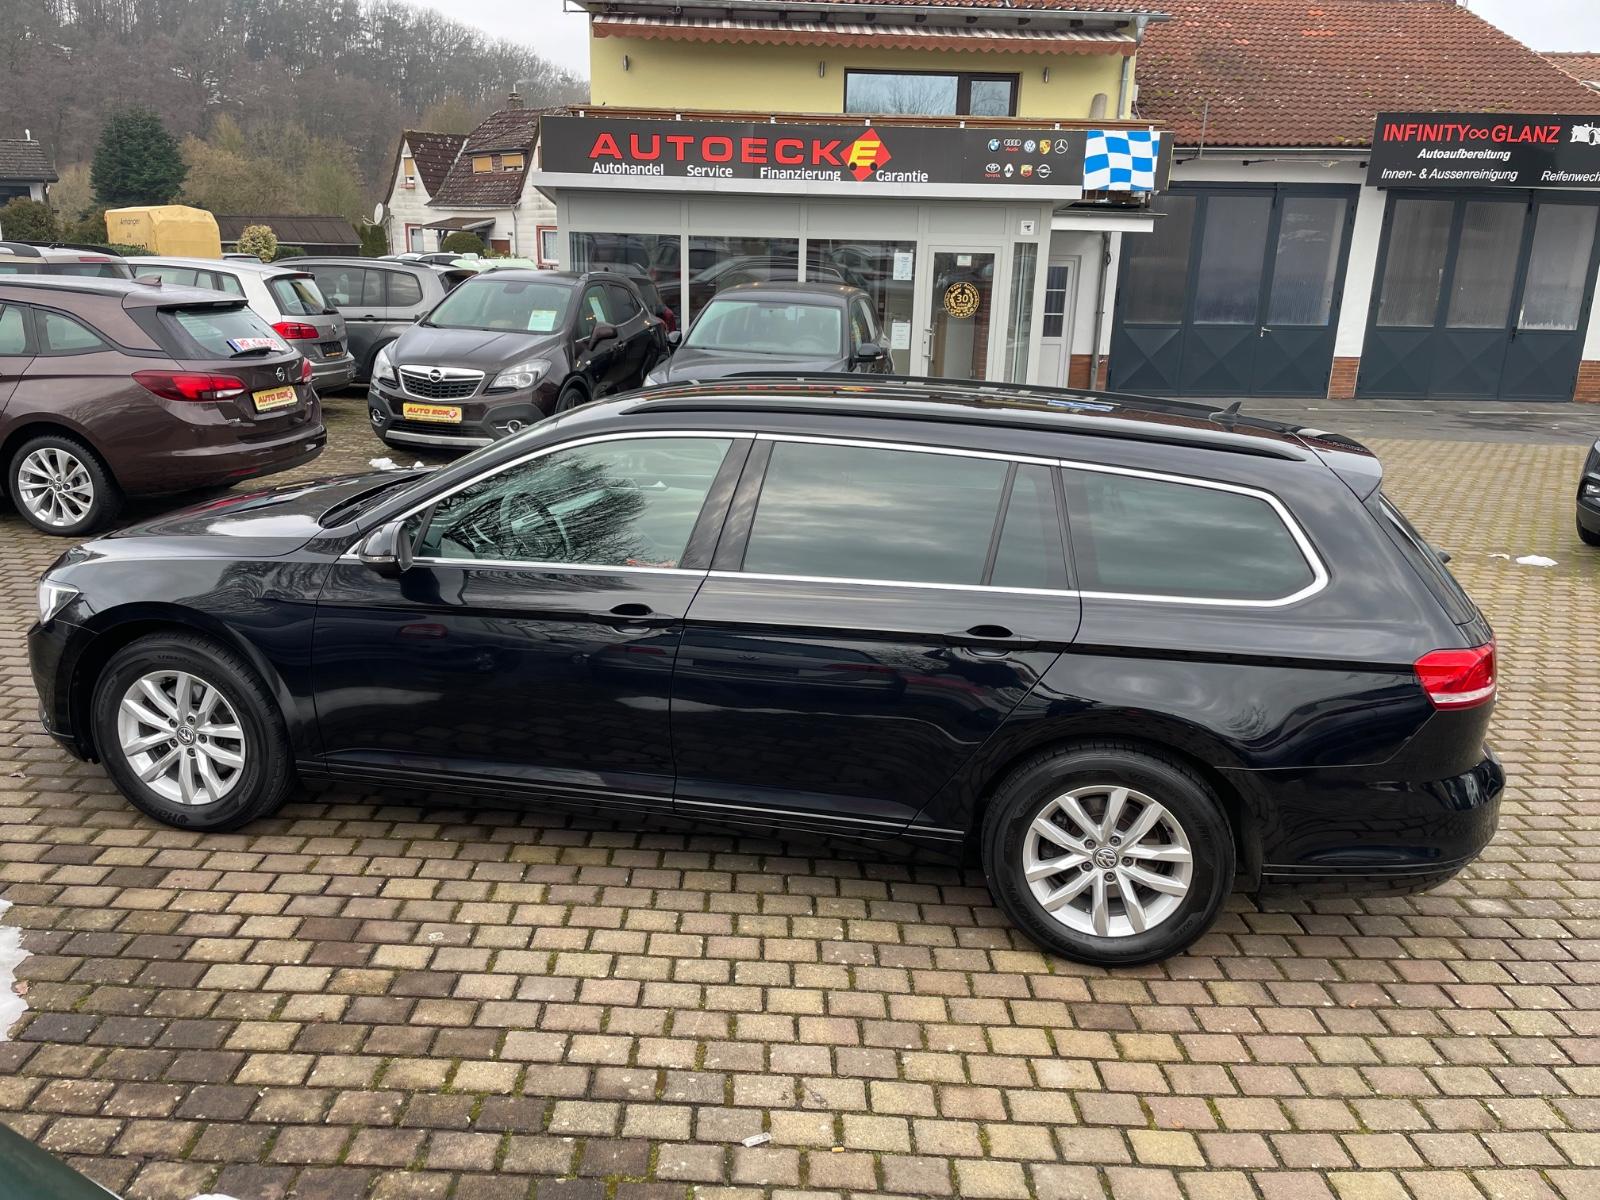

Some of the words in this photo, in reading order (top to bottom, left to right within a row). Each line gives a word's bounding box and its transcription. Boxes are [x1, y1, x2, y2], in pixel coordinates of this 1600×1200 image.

[1383, 124, 1470, 142] INFINITY
[1491, 125, 1561, 143] GLANZ
[588, 132, 844, 166] AUTOECK
[1417, 148, 1511, 162] Autoaufbereitung
[592, 162, 664, 176] Autohandel
[686, 164, 733, 178] Service
[760, 167, 841, 182] Finanzierung
[876, 169, 929, 183] Garantie
[1381, 168, 1416, 180] Innen-
[1419, 168, 1427, 179] &
[1429, 169, 1519, 182] Aussenreinigung
[956, 294, 969, 303] 30
